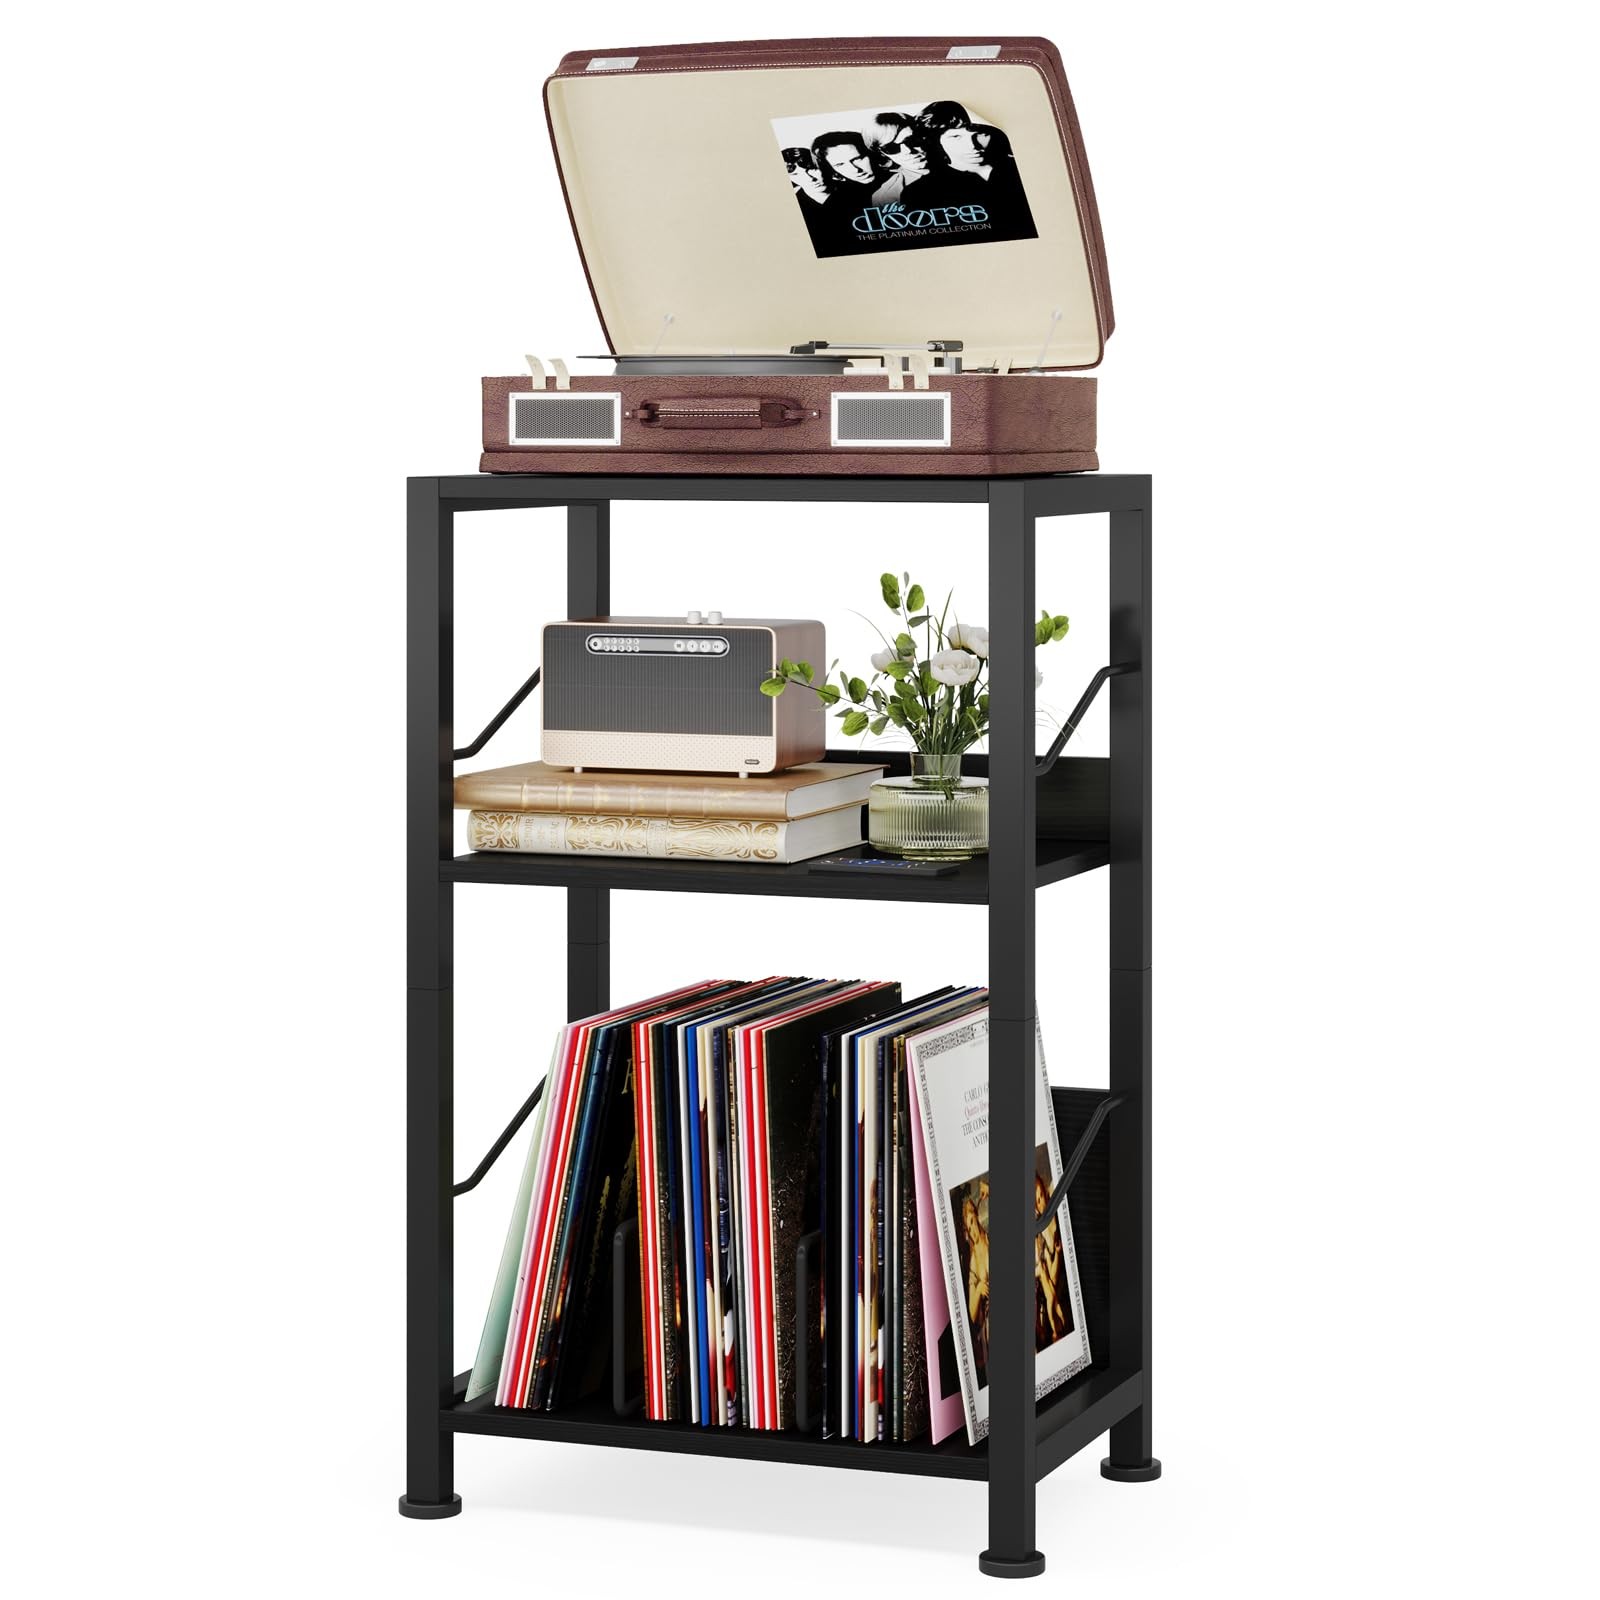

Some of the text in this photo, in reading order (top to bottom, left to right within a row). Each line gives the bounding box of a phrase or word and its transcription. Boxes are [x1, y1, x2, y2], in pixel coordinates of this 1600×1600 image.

[881, 201, 907, 213] the
[852, 205, 989, 233] doors
[878, 229, 927, 239] PLATINUM
[928, 223, 992, 235] COLLECTION
[961, 1115, 988, 1136] THE CONS
